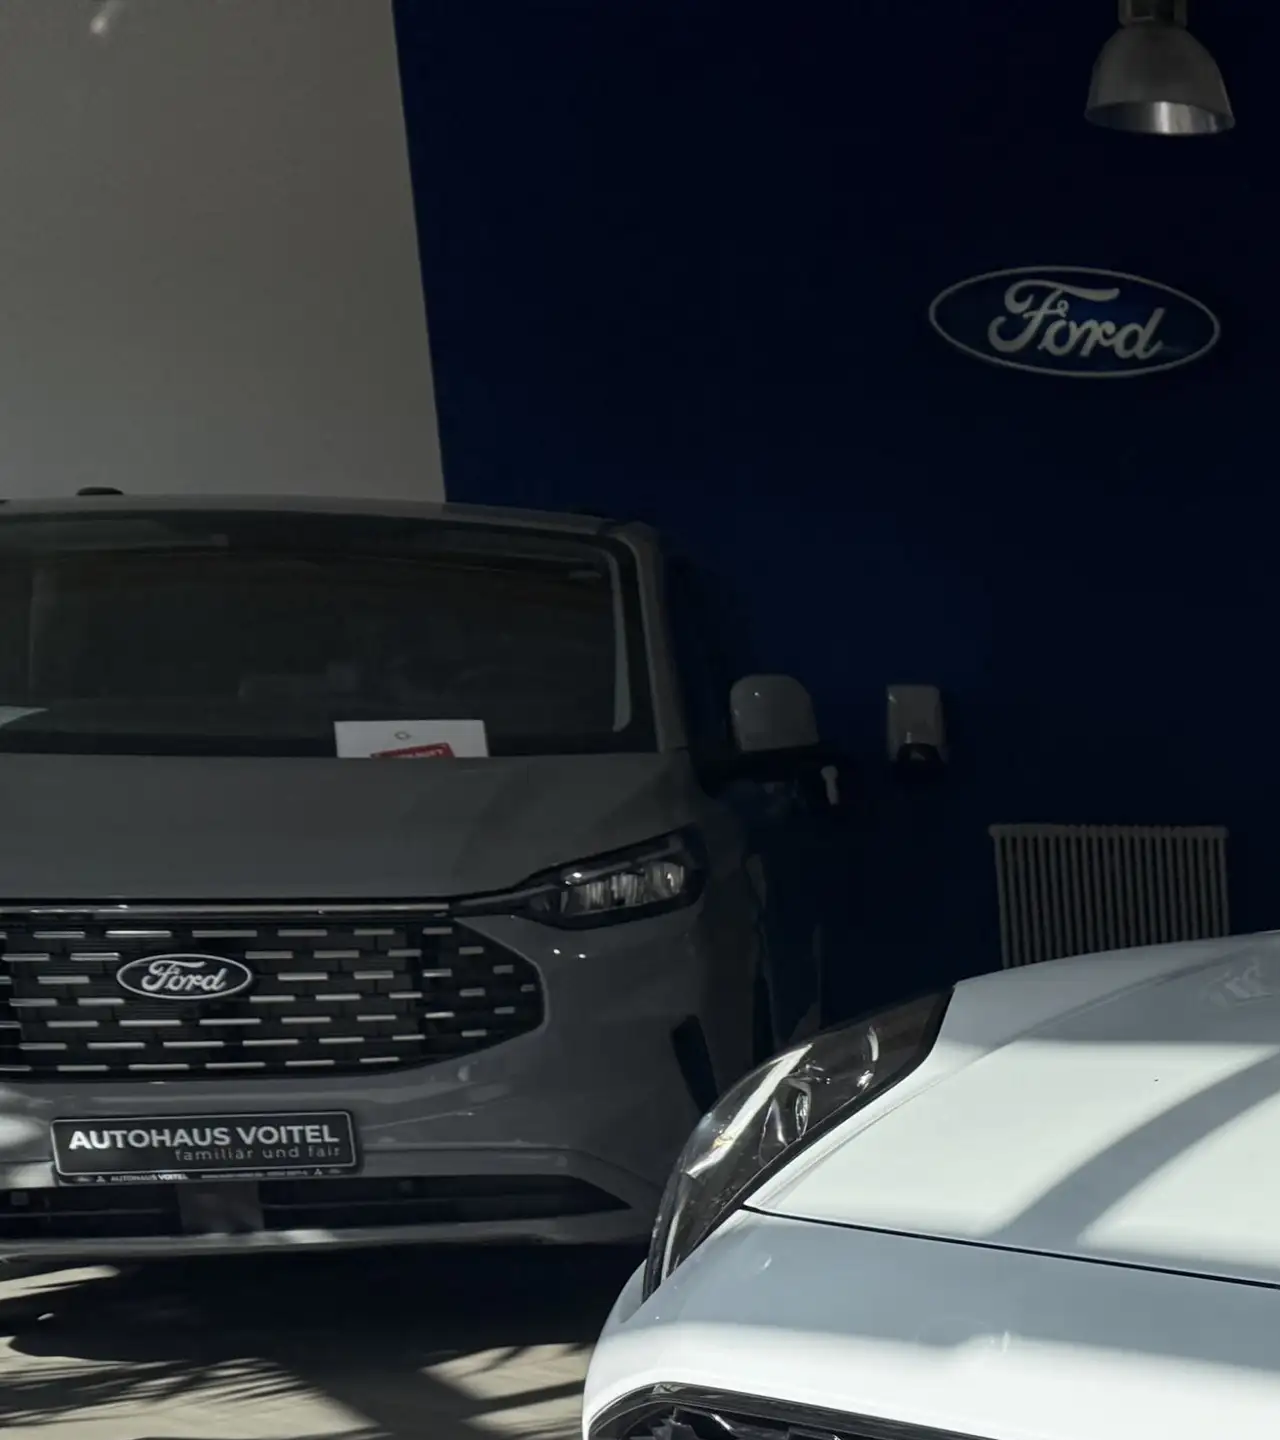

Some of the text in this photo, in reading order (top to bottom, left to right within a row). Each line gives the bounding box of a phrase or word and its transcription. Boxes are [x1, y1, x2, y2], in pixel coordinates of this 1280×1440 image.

[988, 279, 1166, 360] Ford
[141, 960, 229, 991] Ford
[69, 1124, 340, 1150] AUTOHAUS VOITEL
[262, 1147, 300, 1159] und
[308, 1145, 340, 1157] fair
